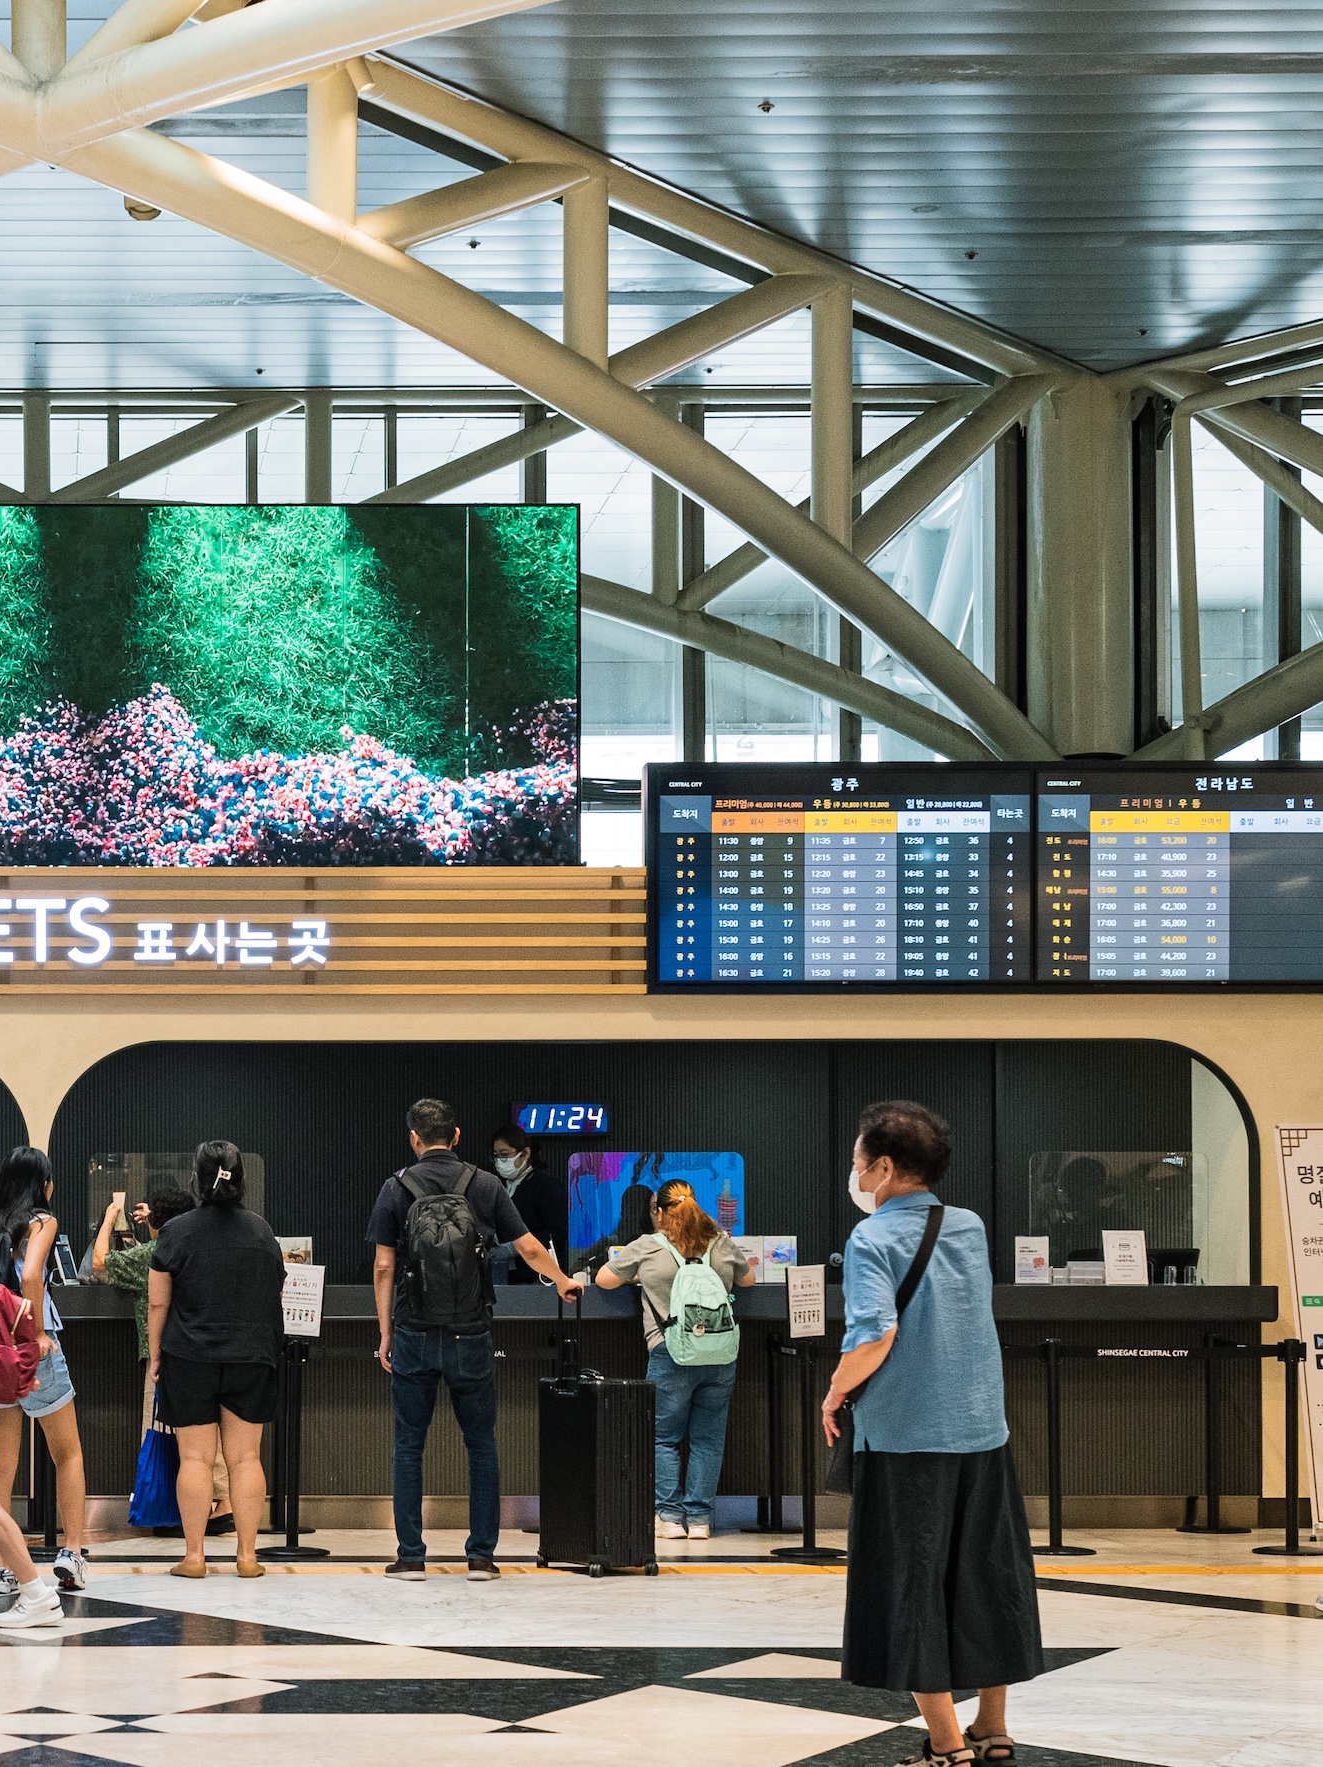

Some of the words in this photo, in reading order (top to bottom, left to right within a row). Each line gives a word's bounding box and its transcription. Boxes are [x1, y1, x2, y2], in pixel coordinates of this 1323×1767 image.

[831, 778, 858, 791] 광주
[1196, 777, 1253, 790] 전라남도
[812, 799, 832, 809] 우등
[905, 799, 926, 809] 일반
[1121, 798, 1162, 808] 프리미엄
[671, 808, 699, 819] 도착지
[995, 808, 1025, 819] 타는곳
[1050, 807, 1077, 819] 도착지
[719, 837, 738, 845] 11:30
[812, 837, 830, 845] 11:35
[905, 837, 924, 845] 12:50
[719, 853, 738, 861] 12:00
[812, 853, 830, 861] 12:15
[905, 853, 924, 861] 13:15
[1097, 853, 1116, 861] 17:10
[1161, 853, 1186, 862] 40,900
[719, 869, 738, 877] 13:00
[812, 869, 830, 877] 12:20
[905, 869, 924, 877] 14:45
[1097, 869, 1116, 877] 14:30
[1161, 869, 1186, 878] 35,900
[719, 886, 738, 894] 14:00
[812, 886, 830, 894] 13:20
[905, 886, 924, 894] 15:10
[719, 903, 738, 911] 14:30
[812, 903, 830, 911] 13:25
[905, 903, 924, 911] 16:50
[1161, 903, 1186, 912] 42,300
[719, 919, 738, 927] 15:00
[812, 919, 830, 927] 14:10
[905, 919, 924, 927] 17:10
[1161, 919, 1186, 928] 36,800
[134, 921, 177, 963] 표
[185, 919, 278, 966] 사는
[288, 919, 331, 966] 곳
[719, 936, 738, 944] 15:30
[812, 936, 830, 944] 14:25
[905, 936, 924, 944] 18:10
[719, 952, 738, 960] 16:00
[812, 952, 830, 960] 15:15
[905, 952, 924, 960] 19:05
[1161, 952, 1186, 961] 44,200
[719, 969, 738, 977] 16:30
[812, 969, 830, 977] 15:20
[905, 969, 924, 977] 19:40
[1161, 969, 1186, 978] 39,600
[528, 1106, 603, 1134] 11:24
[1097, 1349, 1138, 1357] SHINSEGAE
[1138, 1349, 1171, 1357] CENTRAL
